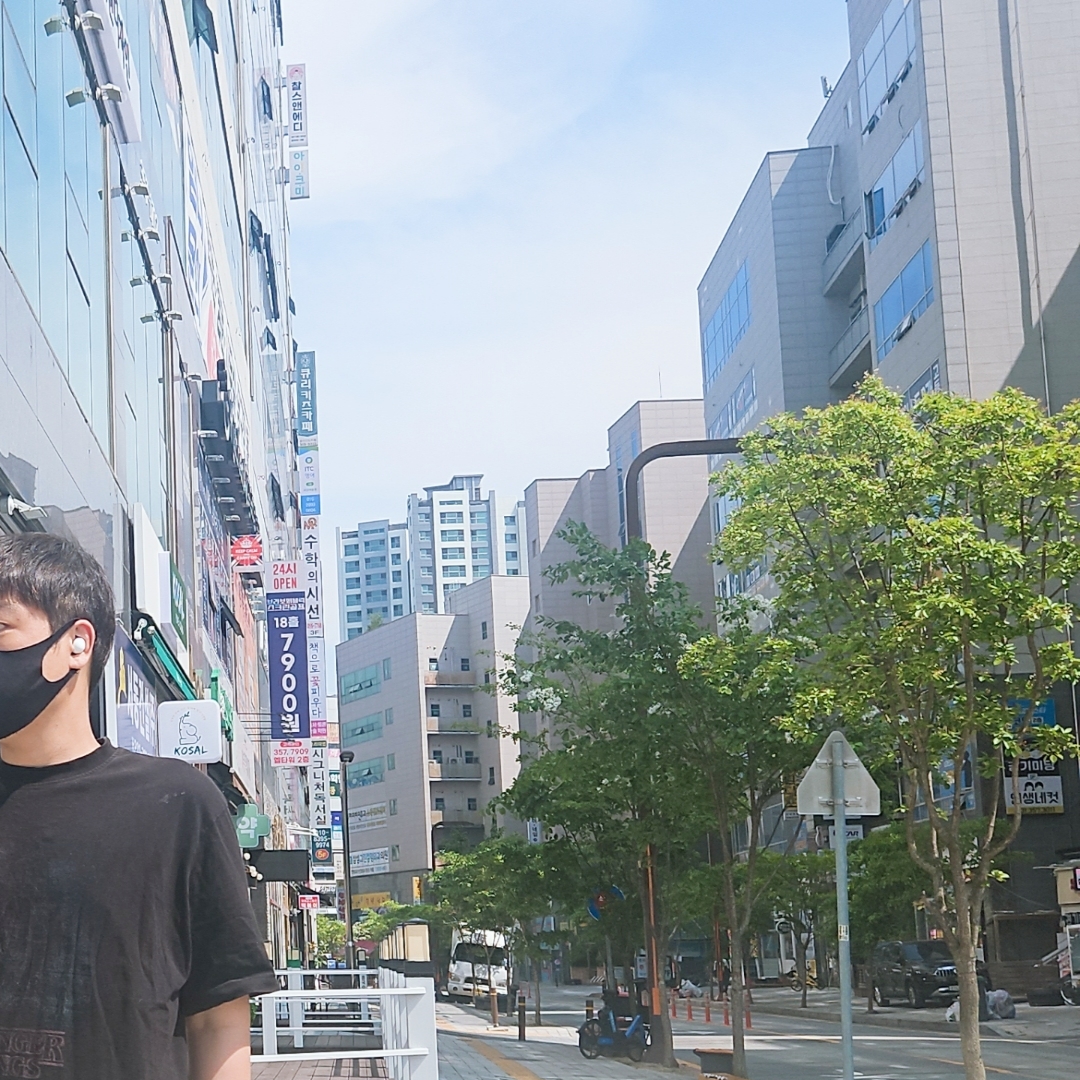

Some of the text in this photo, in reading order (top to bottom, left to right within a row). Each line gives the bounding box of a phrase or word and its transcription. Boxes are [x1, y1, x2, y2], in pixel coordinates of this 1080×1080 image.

[273, 563, 297, 576] 24시
[273, 577, 297, 590] OPEN
[274, 616, 299, 629] 18홀
[174, 746, 208, 756] KOSAL
[237, 816, 258, 838] 약
